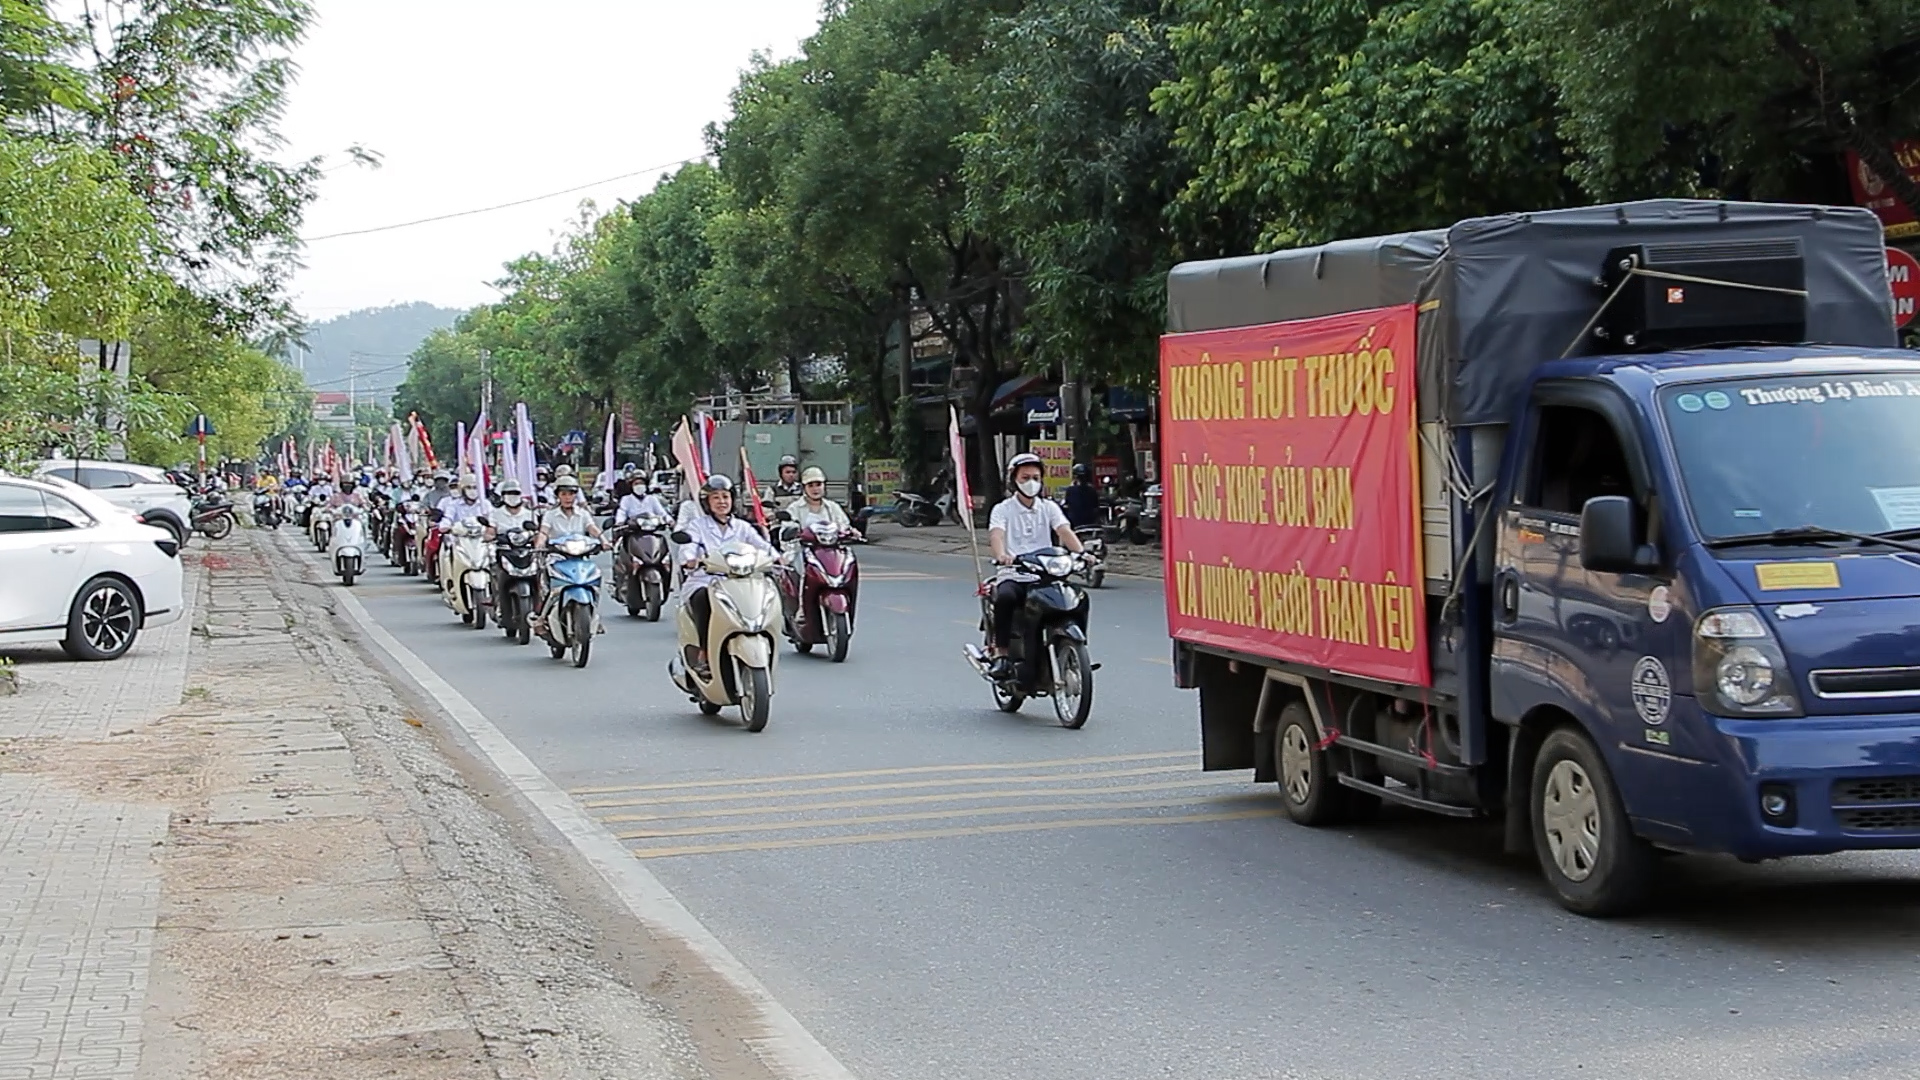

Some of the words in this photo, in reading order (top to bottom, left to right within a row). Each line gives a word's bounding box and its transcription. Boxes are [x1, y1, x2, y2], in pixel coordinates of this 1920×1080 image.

[1170, 352, 1245, 421] KHÔNG
[1251, 346, 1298, 419] HÚT
[1304, 326, 1395, 417] THUỐC
[1741, 386, 1826, 405] Thượng
[1822, 382, 1852, 400] Lộ
[1850, 380, 1904, 398] Bình
[1172, 453, 1190, 519] VÌ
[1193, 452, 1222, 522] SỨC
[1225, 444, 1269, 526] KHỎE
[1272, 445, 1310, 528] CỦA
[1314, 466, 1354, 544] BẠN
[1175, 551, 1199, 618] VÀ
[1200, 556, 1257, 629] NHỮNG
[1258, 560, 1313, 637] NGƯỜI
[1316, 567, 1369, 646] THÂN
[1370, 571, 1415, 653] YÊU
